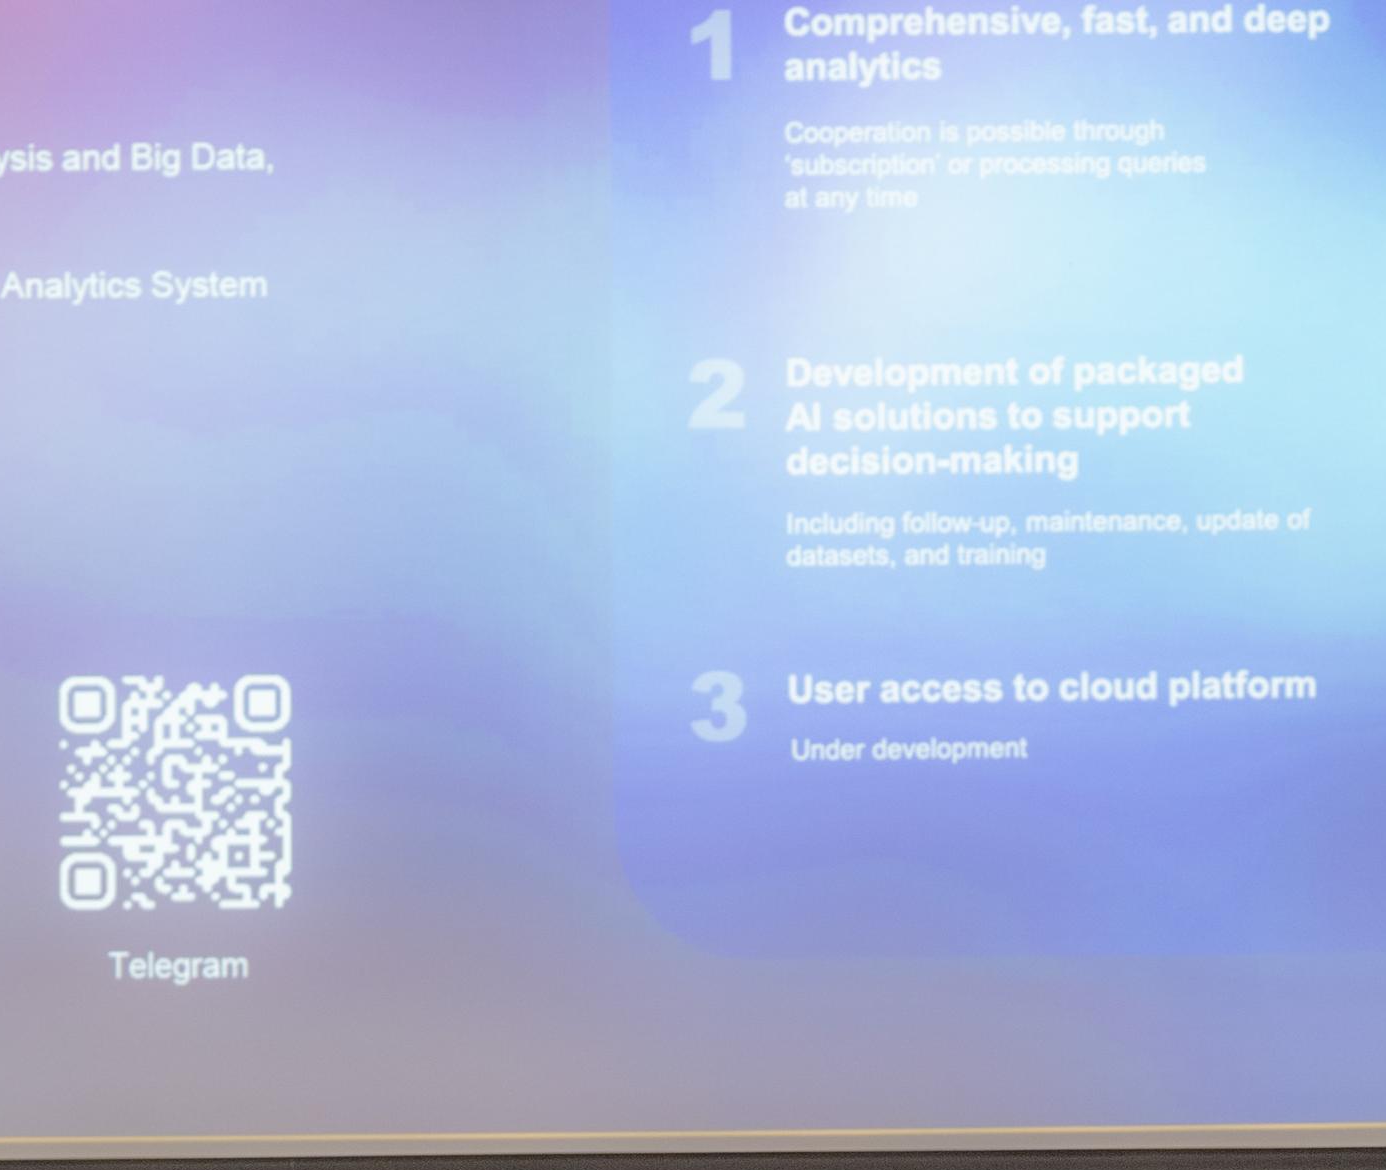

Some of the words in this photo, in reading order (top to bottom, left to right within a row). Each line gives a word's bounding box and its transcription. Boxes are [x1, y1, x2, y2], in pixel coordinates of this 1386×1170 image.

[784, 6, 1070, 41] Comprehensive,
[1082, 5, 1157, 38] fast,
[1168, 4, 1233, 33] and
[1244, 3, 1331, 40] deep
[691, 9, 732, 81] 1
[784, 51, 941, 88] analytics
[784, 121, 931, 147] Cooperation
[940, 121, 959, 142] is
[967, 121, 1066, 146] possible
[1073, 119, 1165, 147] through
[62, 143, 120, 171] and
[132, 142, 180, 177] Big
[192, 142, 273, 172] Data,
[948, 157, 972, 175] or
[980, 156, 1111, 179] processing
[1117, 153, 1206, 179] queries
[784, 186, 808, 209] at
[815, 191, 858, 212] any
[866, 186, 918, 209] time
[1, 272, 141, 305] Analytics
[152, 271, 267, 304] System
[787, 358, 1018, 393] Development
[1029, 355, 1065, 385] of
[1074, 354, 1245, 392] packaged
[689, 358, 745, 429] 2
[786, 402, 821, 431] AI
[835, 401, 998, 431] solutions
[1007, 402, 1043, 430] to
[1052, 400, 1190, 437] support
[786, 444, 1078, 482] decision-making
[787, 512, 896, 538] Including
[902, 511, 1017, 538] follow-up,
[1025, 511, 1188, 533] maintenance,
[1196, 509, 1280, 535] update
[1287, 507, 1312, 530] of
[785, 545, 895, 568] datasets,
[904, 544, 950, 566] and
[957, 544, 1046, 570] training
[691, 670, 747, 742] 3
[789, 674, 871, 704] User
[880, 679, 1003, 703] access
[1013, 674, 1049, 702] to
[1059, 671, 1158, 702] cloud
[1169, 669, 1316, 707] platform
[791, 738, 866, 762] Under
[871, 737, 1028, 764] development
[108, 951, 249, 985] Telegram
